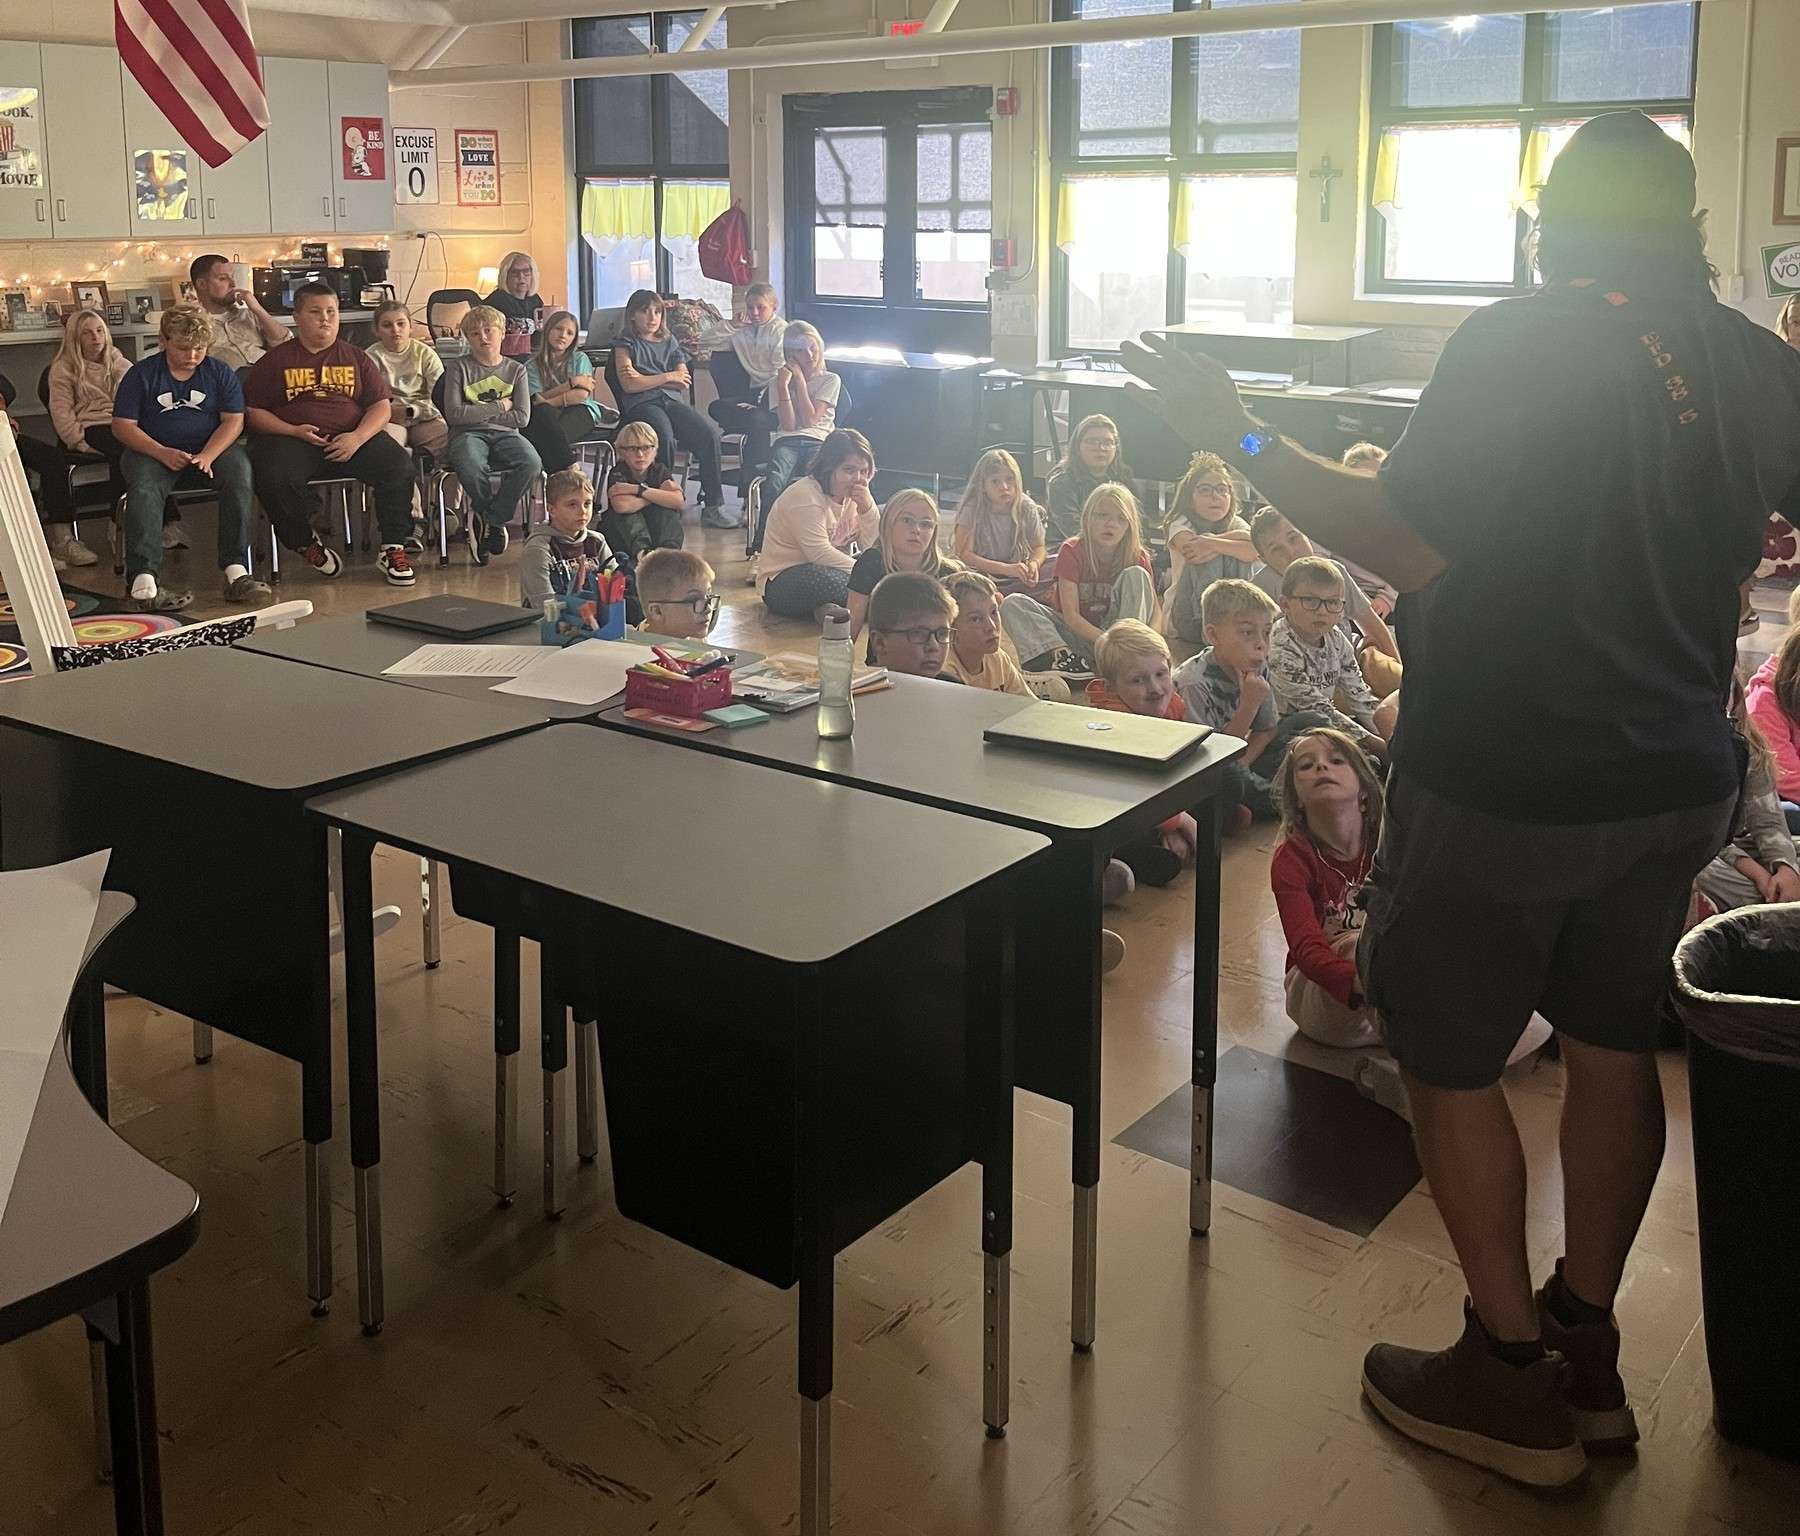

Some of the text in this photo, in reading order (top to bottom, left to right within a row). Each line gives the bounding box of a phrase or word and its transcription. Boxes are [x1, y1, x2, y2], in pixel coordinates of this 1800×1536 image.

[3, 107, 33, 118] OOK,
[368, 131, 380, 141] BE
[395, 135, 434, 149] EXCUSE
[366, 141, 384, 149] KIND
[461, 136, 477, 149] DO
[401, 151, 429, 164] LIMIT
[467, 153, 489, 162] LOVE
[480, 189, 496, 200] DO
[1775, 263, 1800, 278] VO
[285, 365, 355, 387] WE ARE
